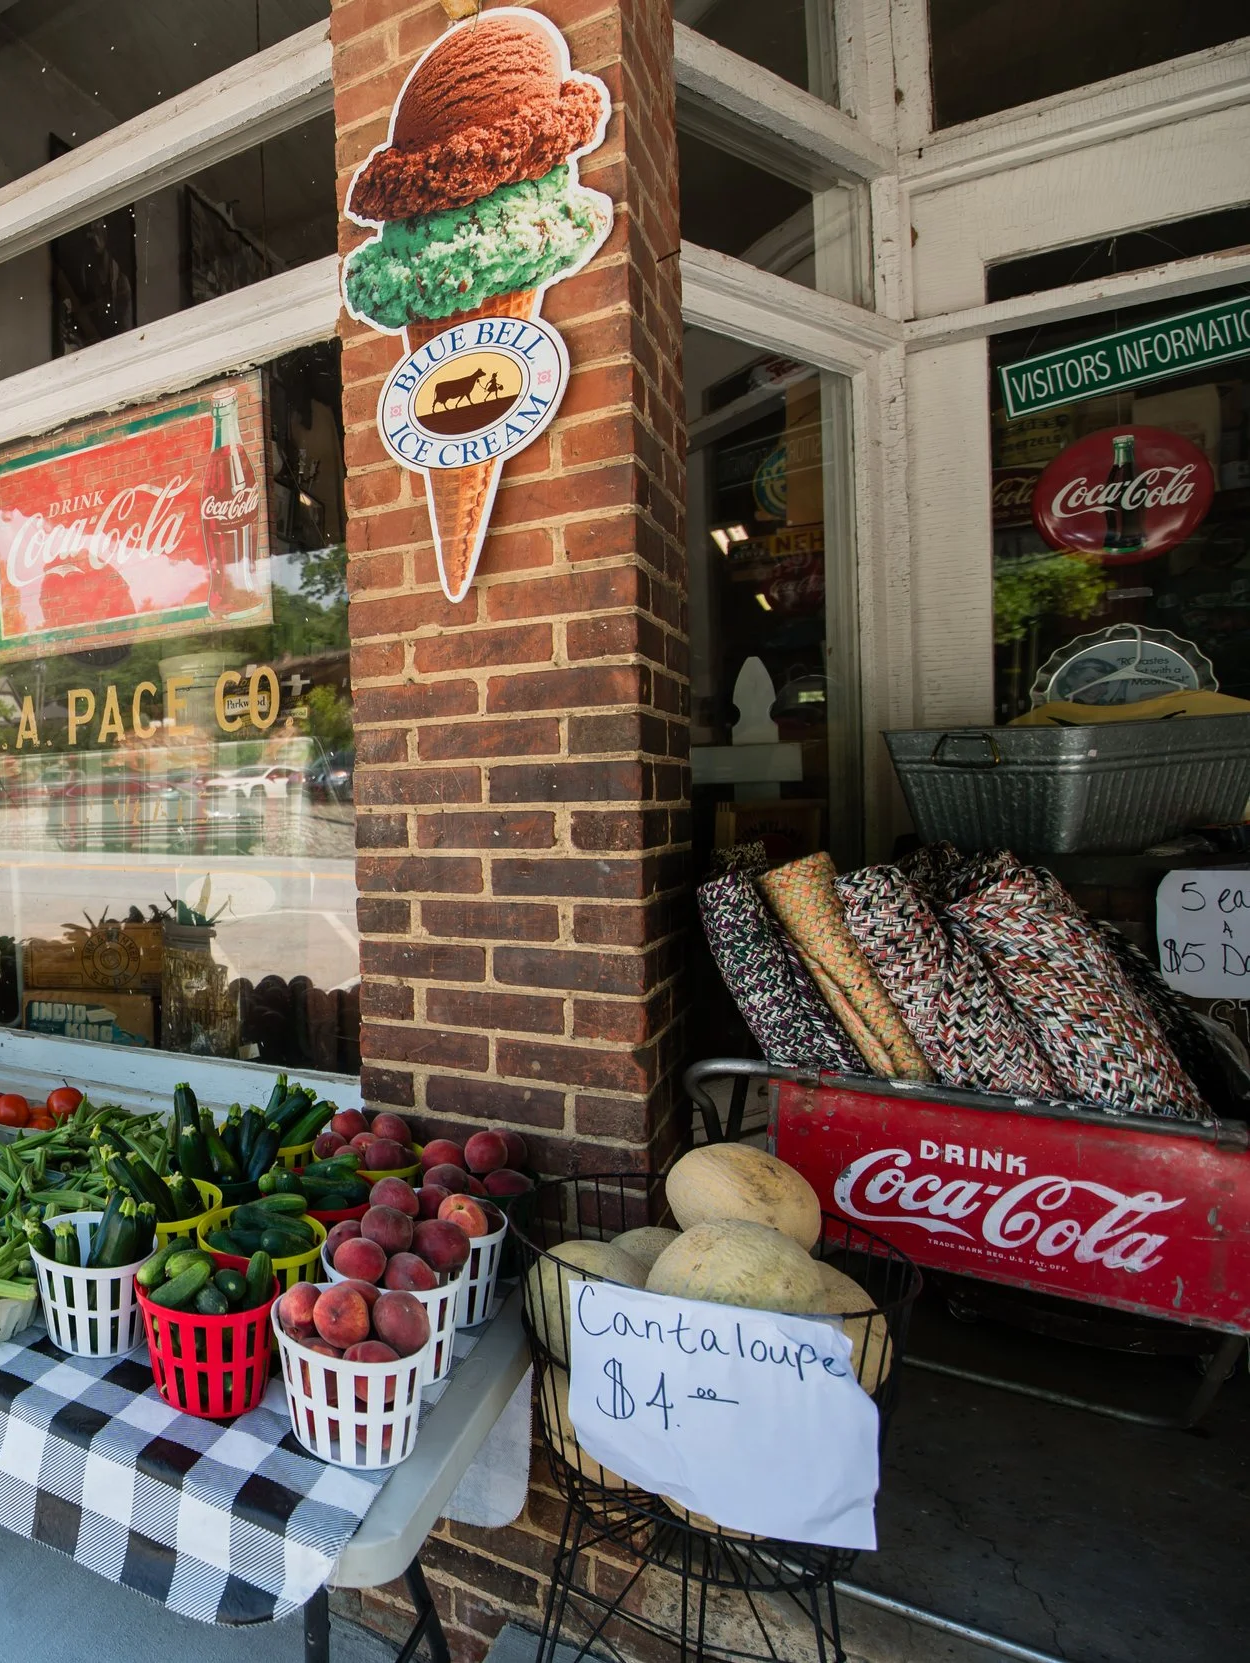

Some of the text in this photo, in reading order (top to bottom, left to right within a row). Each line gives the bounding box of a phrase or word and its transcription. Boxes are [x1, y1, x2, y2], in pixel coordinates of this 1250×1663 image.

[393, 321, 544, 393] BLUE BELL
[1012, 350, 1111, 403] VISITORS
[389, 393, 550, 466] ICE CREAM
[49, 489, 105, 518] DRINK
[201, 481, 259, 520] Coca-Cola
[1051, 464, 1198, 518] Coca-Cola
[7, 474, 195, 587] Coca-Cola
[67, 677, 194, 744] PACE
[1163, 938, 1206, 975] $5
[920, 1140, 1027, 1176] DRINK
[834, 1148, 1186, 1273] Coca-Cola
[927, 1238, 955, 1249] TRADE
[958, 1244, 983, 1255] MARK
[577, 1285, 847, 1380] Cantaloupe
